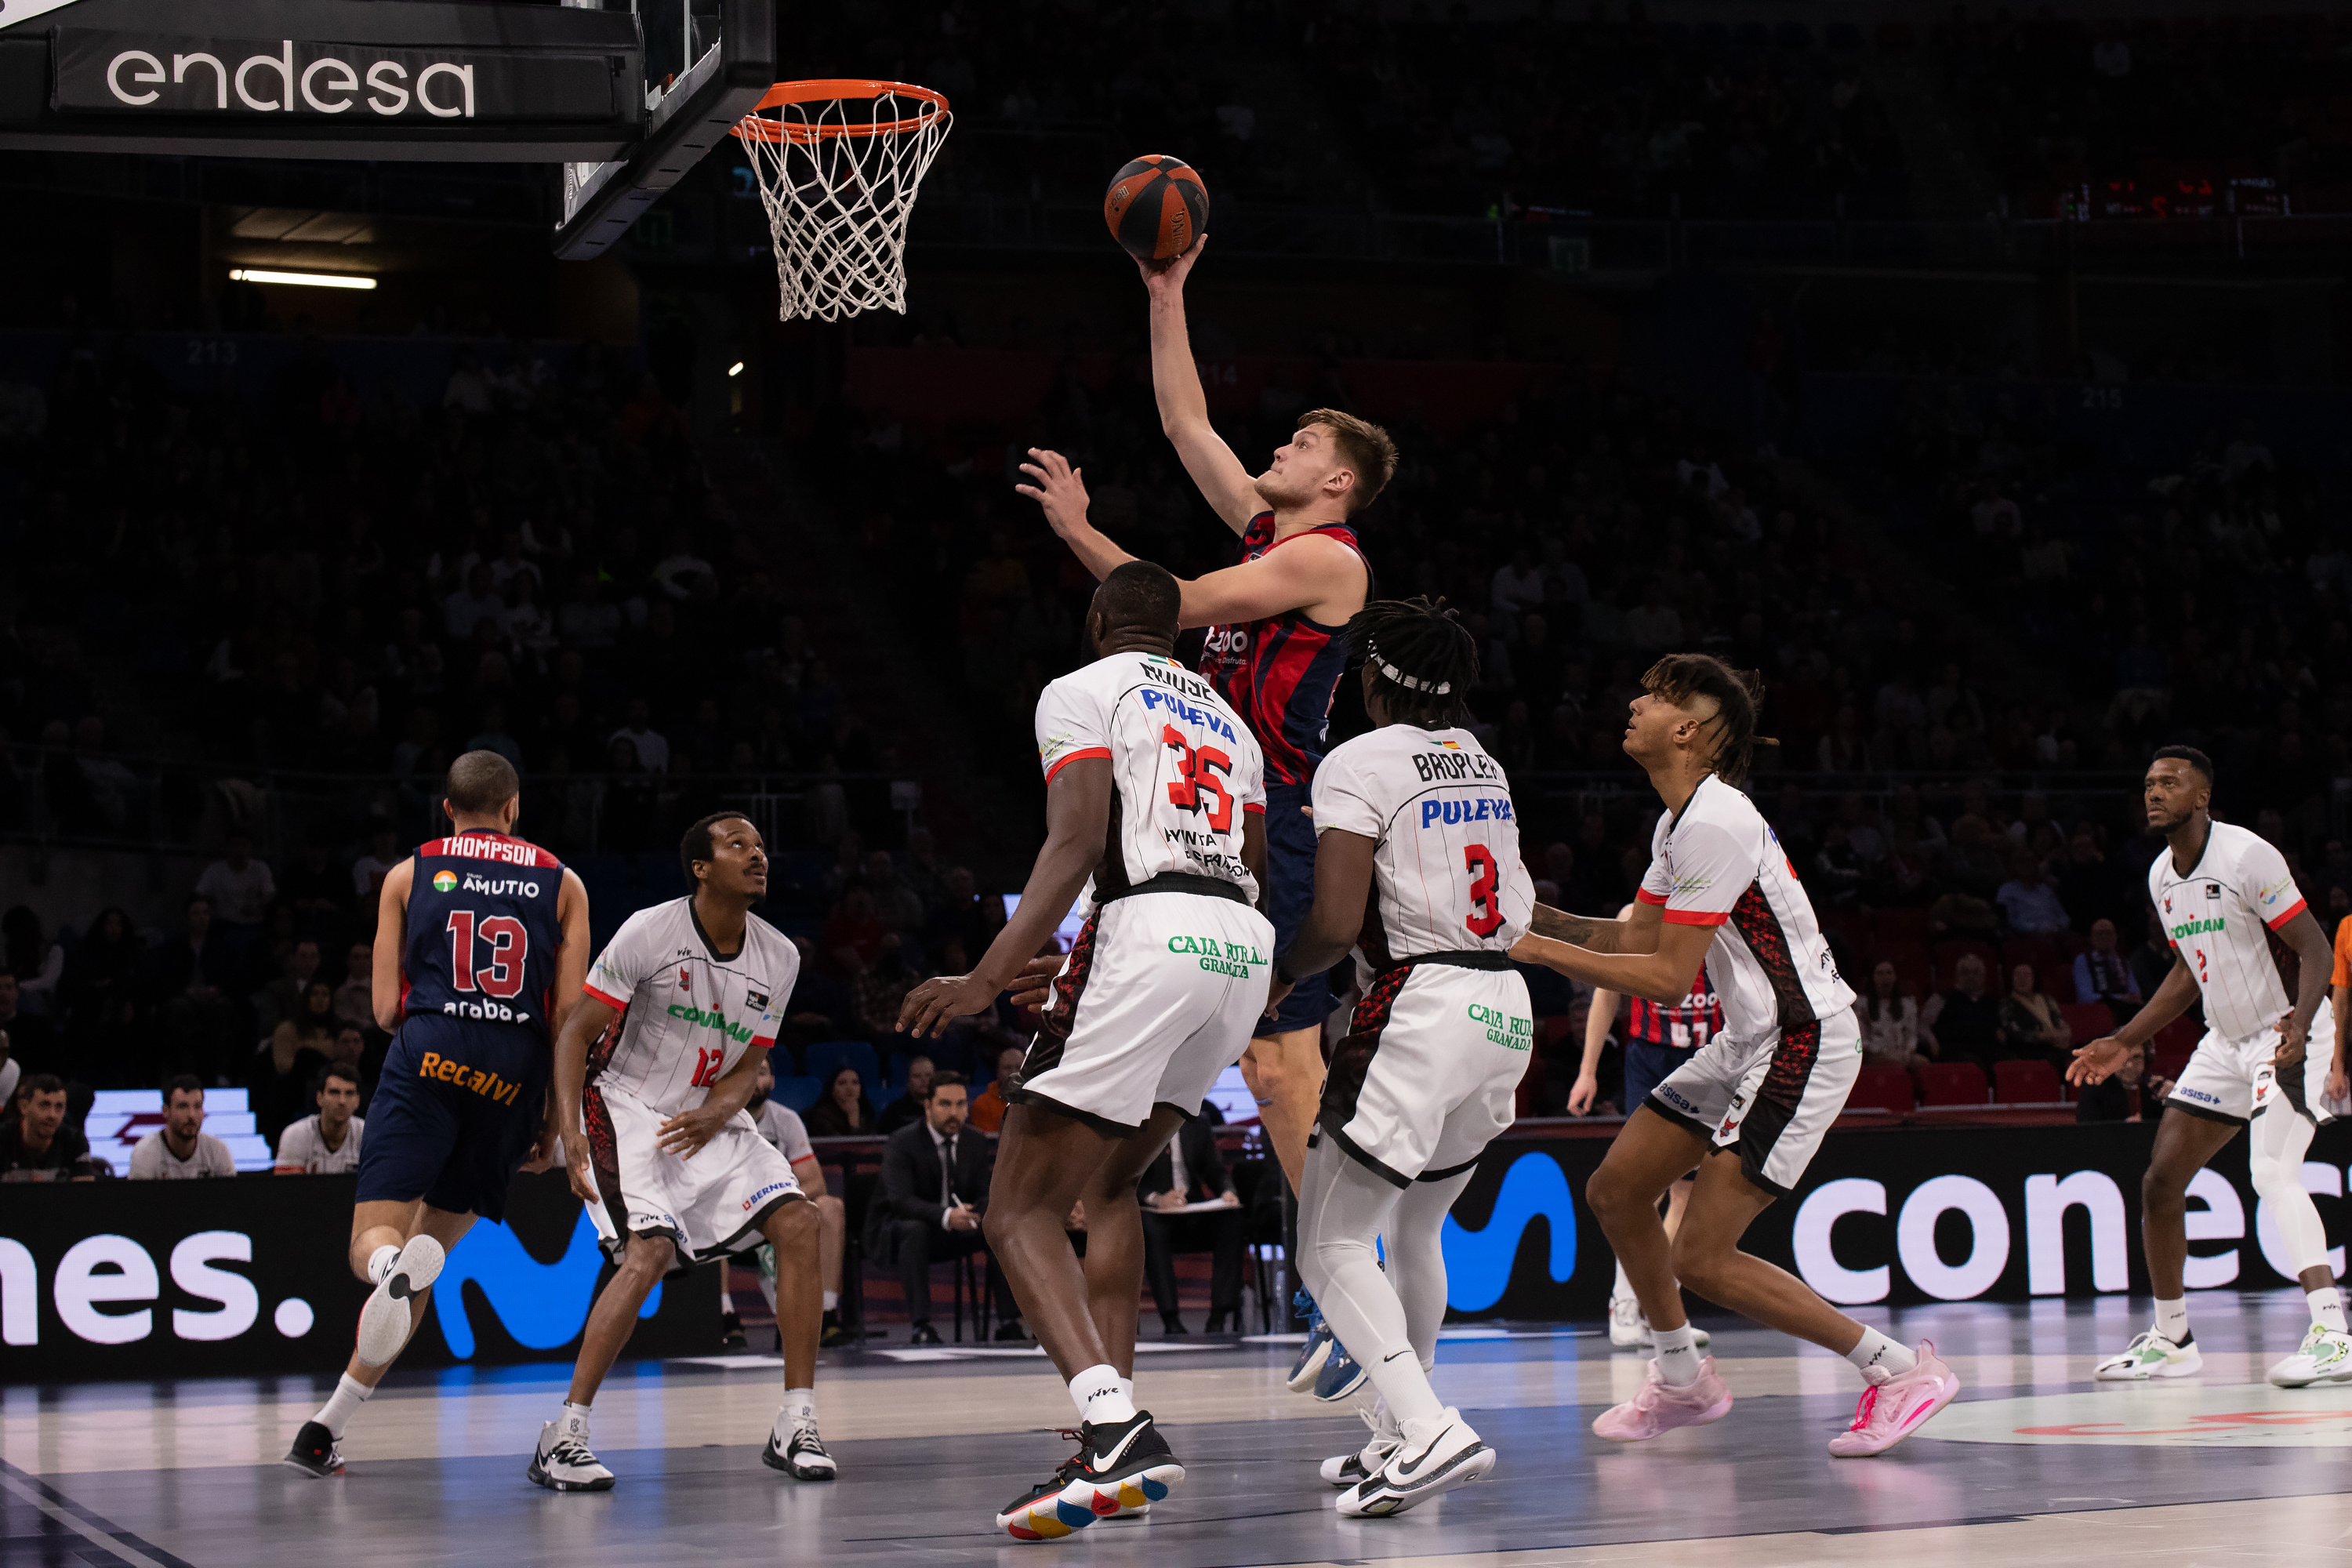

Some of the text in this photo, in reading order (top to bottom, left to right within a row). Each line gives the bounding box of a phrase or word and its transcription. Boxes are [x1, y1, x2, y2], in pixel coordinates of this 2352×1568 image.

[107, 40, 474, 118] endesa
[1140, 689, 1236, 746] PULEVA
[1163, 724, 1236, 838] 35
[1421, 798, 1512, 829] PULEVA
[442, 837, 537, 866] THOMPSON
[463, 877, 539, 898] AMUTIO
[1464, 844, 1507, 939] 3
[446, 910, 528, 999] 13
[1167, 935, 1221, 958] CAJA
[1468, 1004, 1533, 1037] CAJA RUR
[1486, 1028, 1531, 1051] GRANADA
[419, 1051, 522, 1106] Recalvi
[691, 1047, 724, 1087] 12
[1659, 1083, 1690, 1110] asisa
[2180, 1087, 2212, 1102] asisa
[1792, 1161, 2352, 1305] conec
[1087, 1387, 1119, 1403] vive
